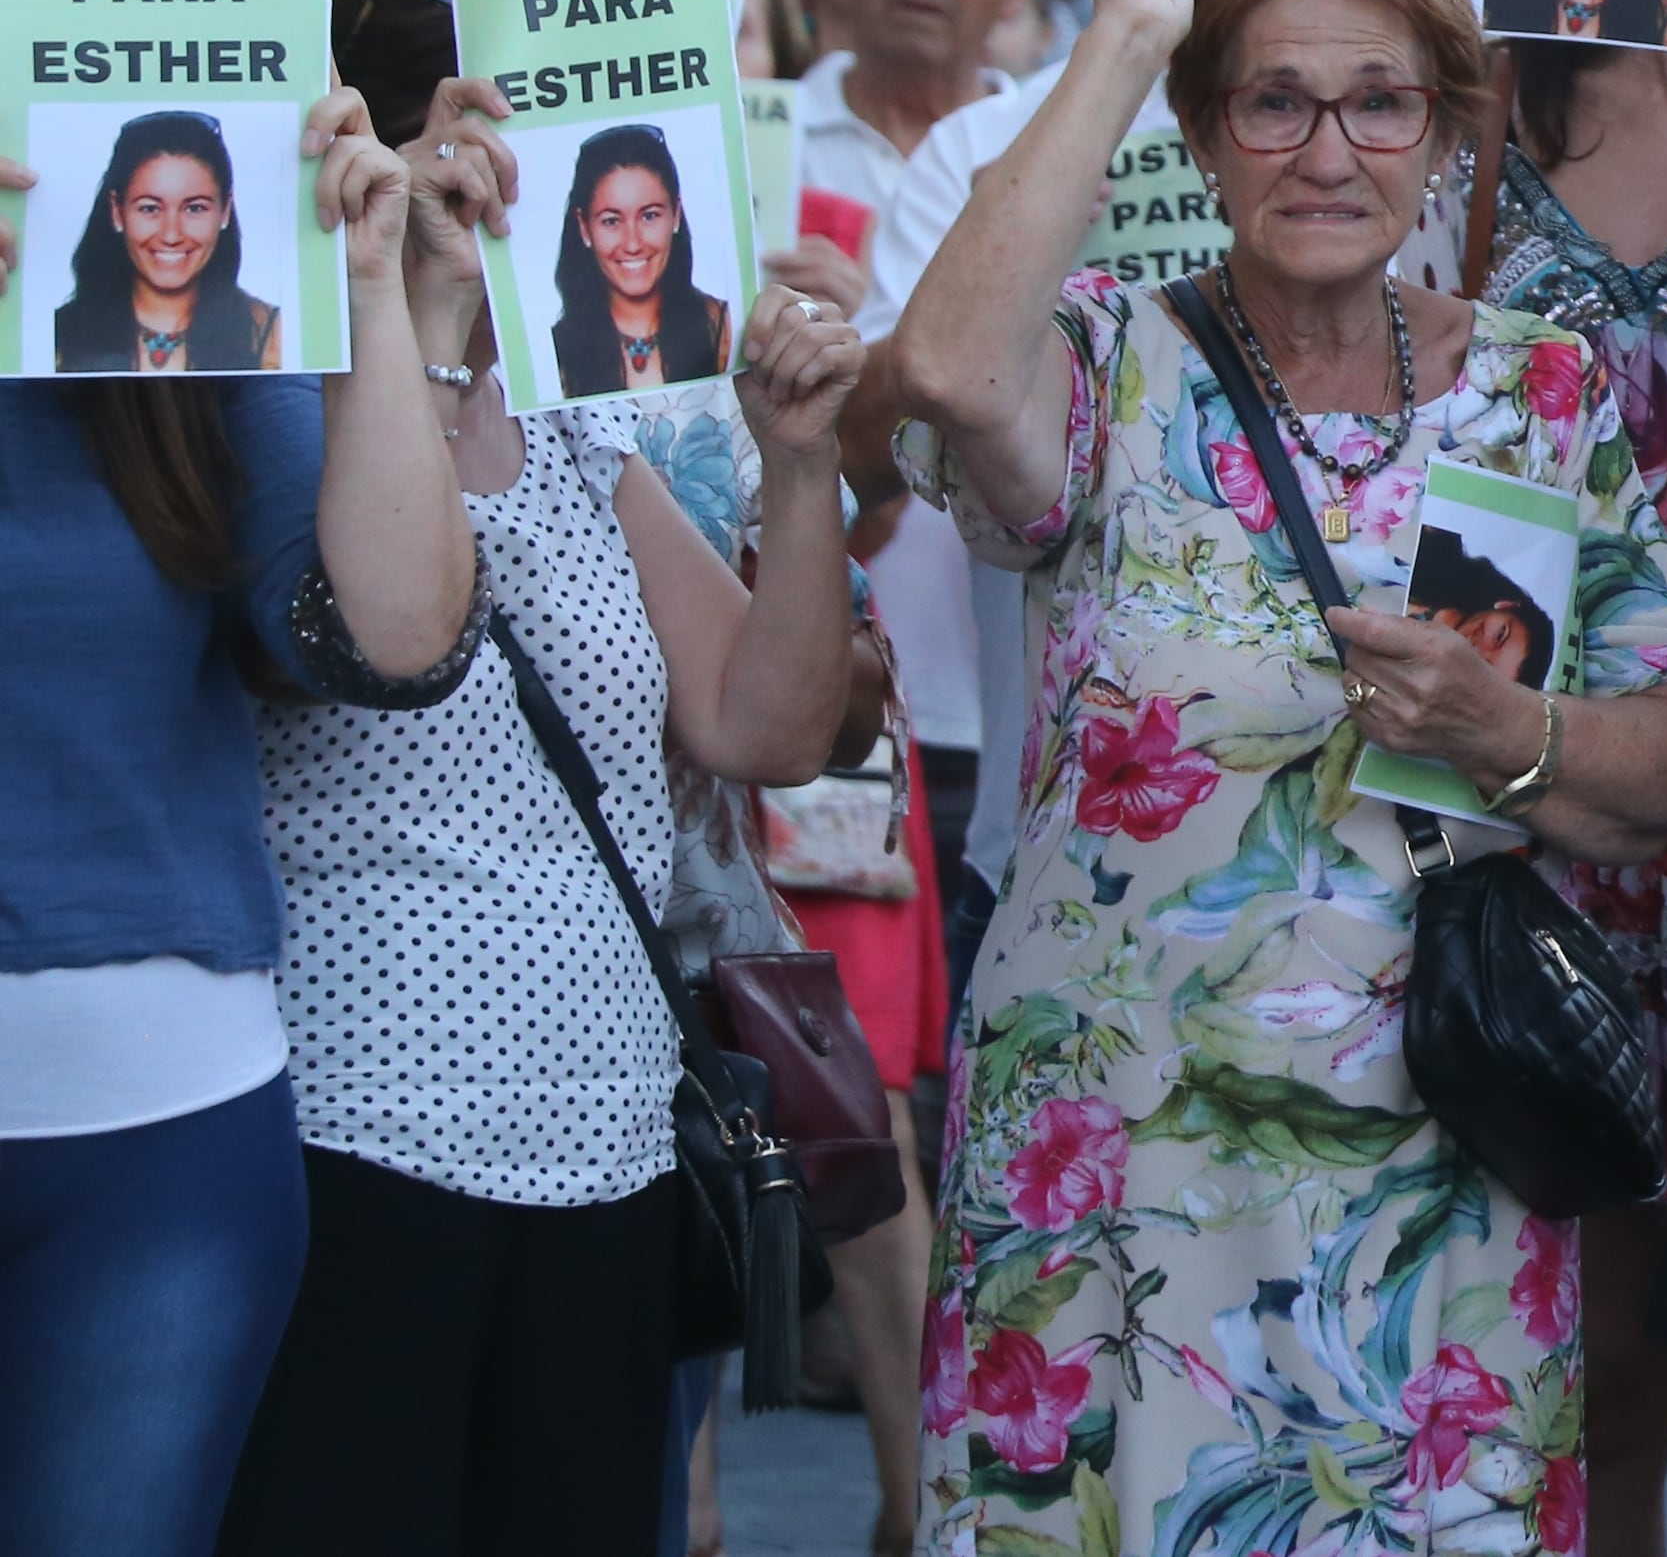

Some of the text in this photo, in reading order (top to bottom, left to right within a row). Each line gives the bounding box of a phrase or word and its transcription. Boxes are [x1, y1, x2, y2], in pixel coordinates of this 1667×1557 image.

[33, 41, 288, 83] ESTHER
[494, 47, 710, 112] ESTHER
[1112, 192, 1217, 231] PAR
